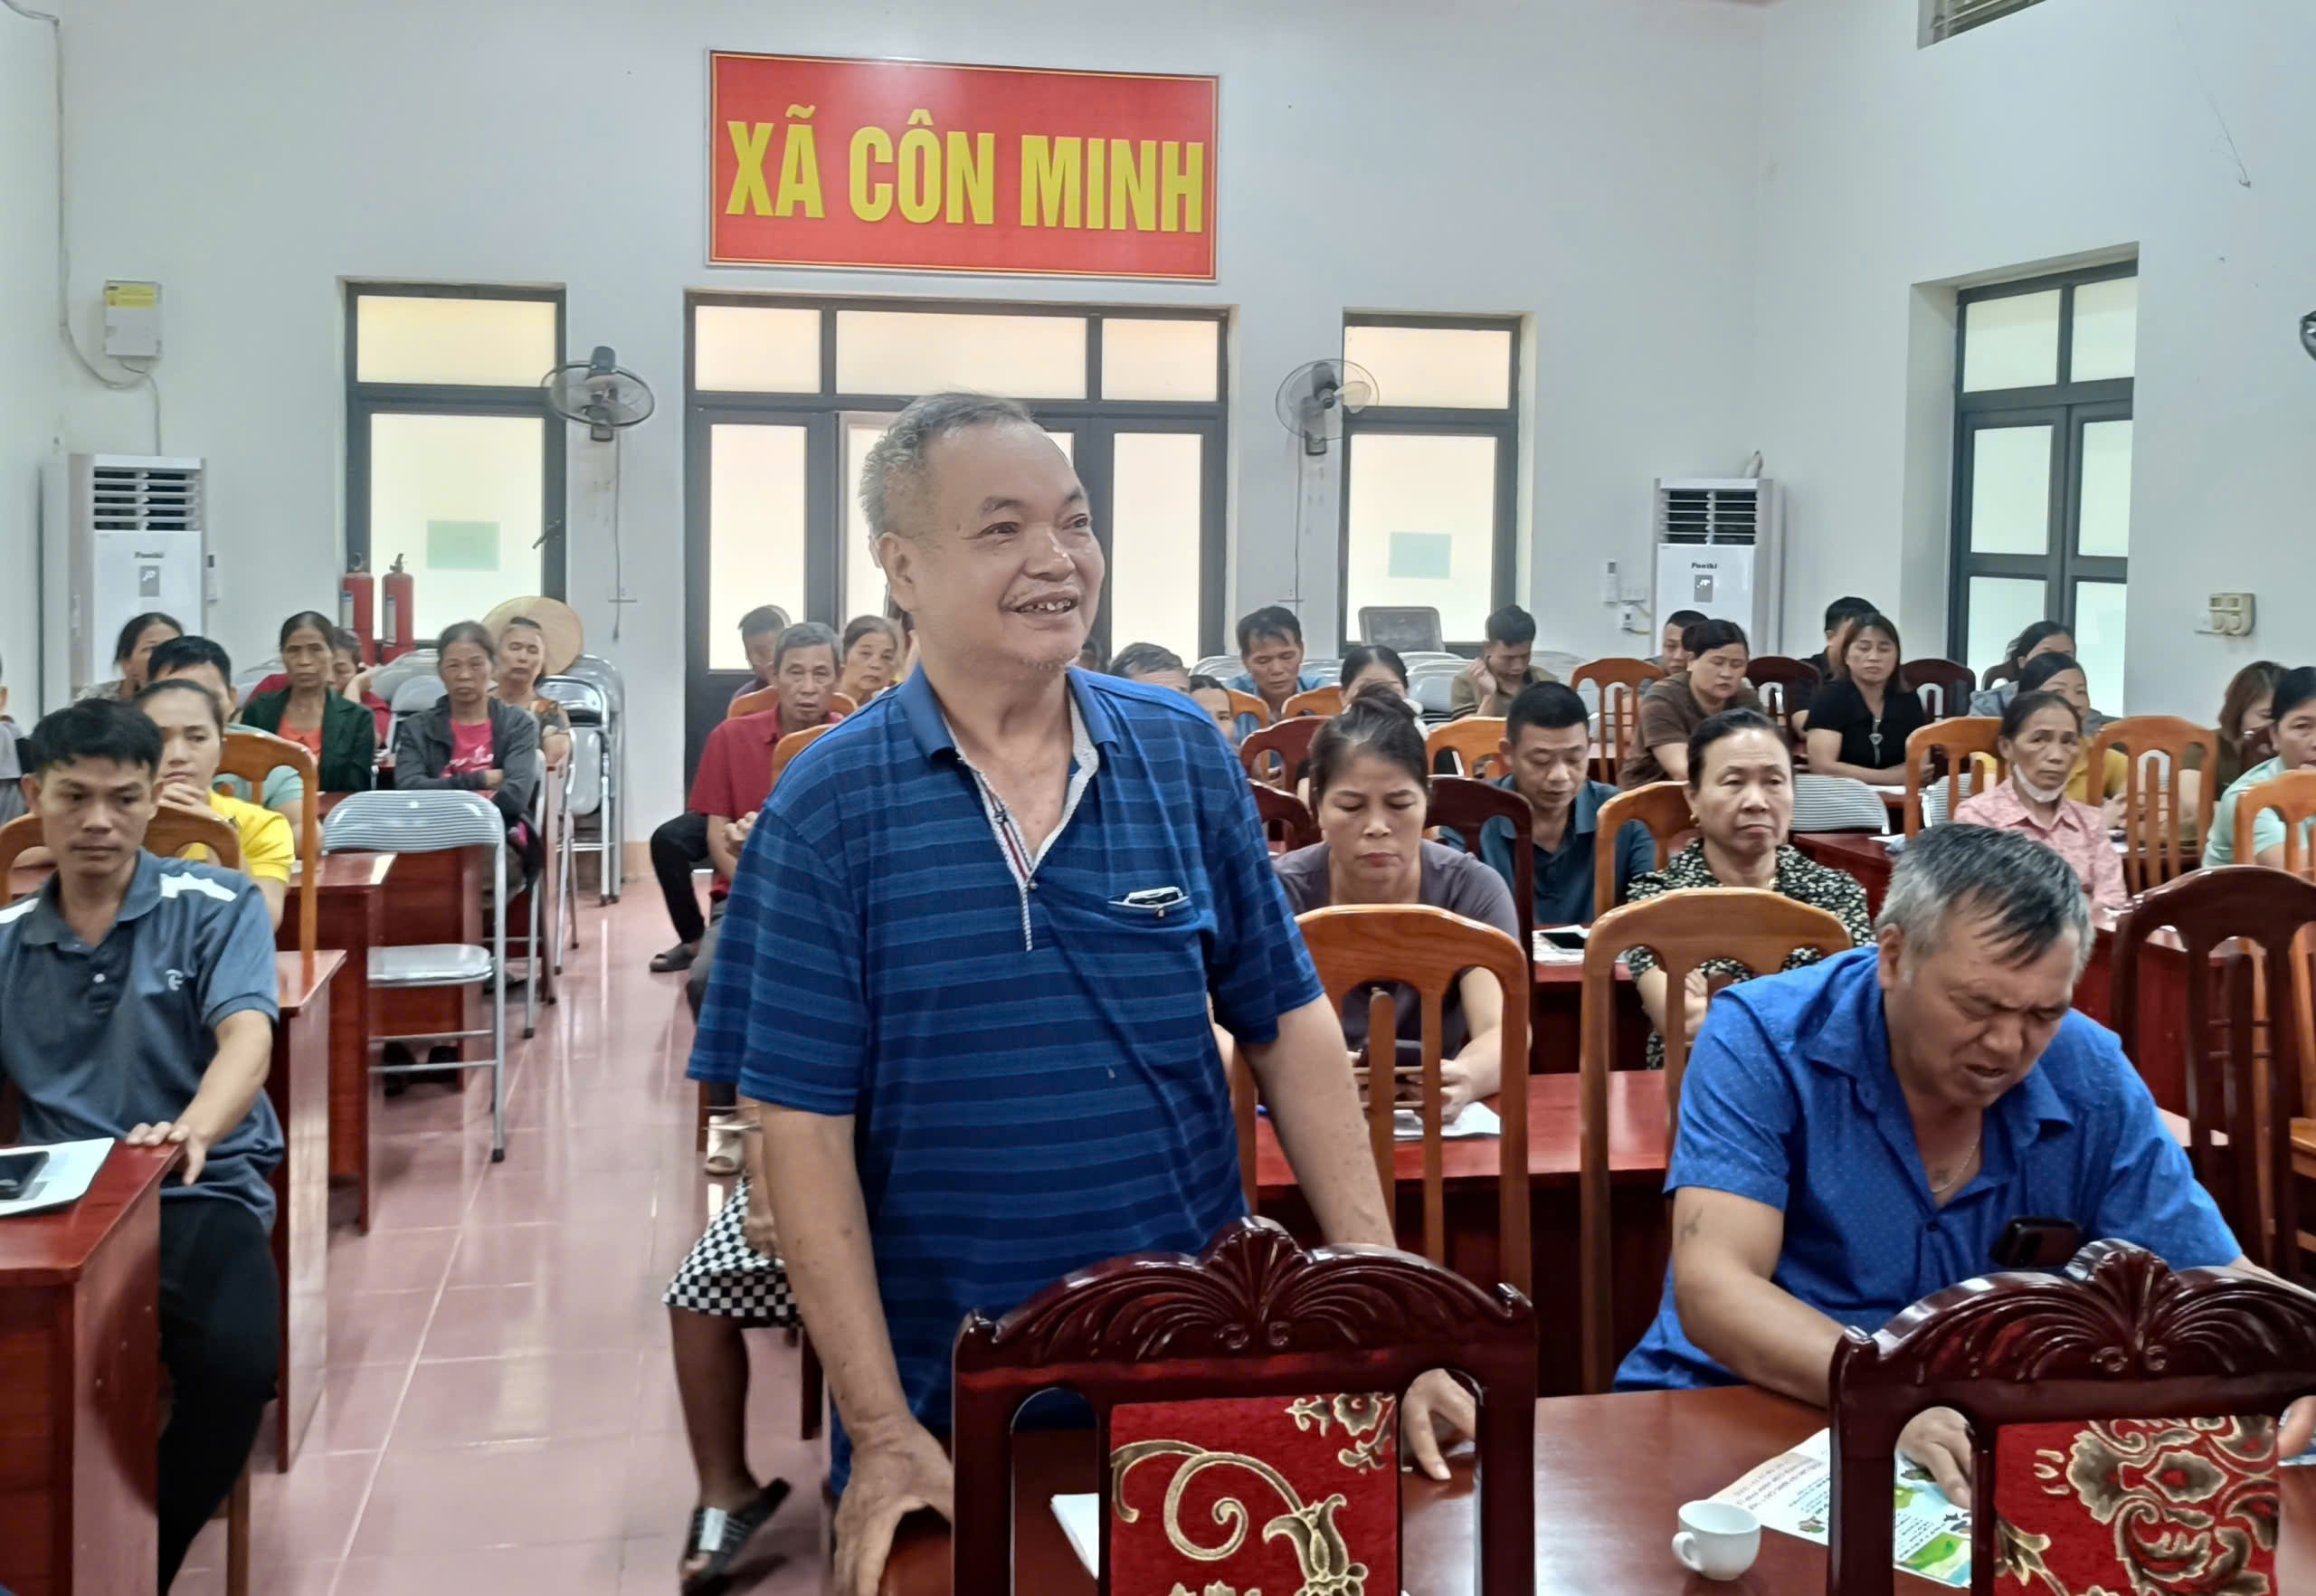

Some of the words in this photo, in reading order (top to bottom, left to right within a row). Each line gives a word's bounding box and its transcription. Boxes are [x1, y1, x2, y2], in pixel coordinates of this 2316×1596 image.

[726, 103, 824, 219] XÃ
[849, 108, 995, 224] CÔN
[1020, 134, 1203, 233] MINH
